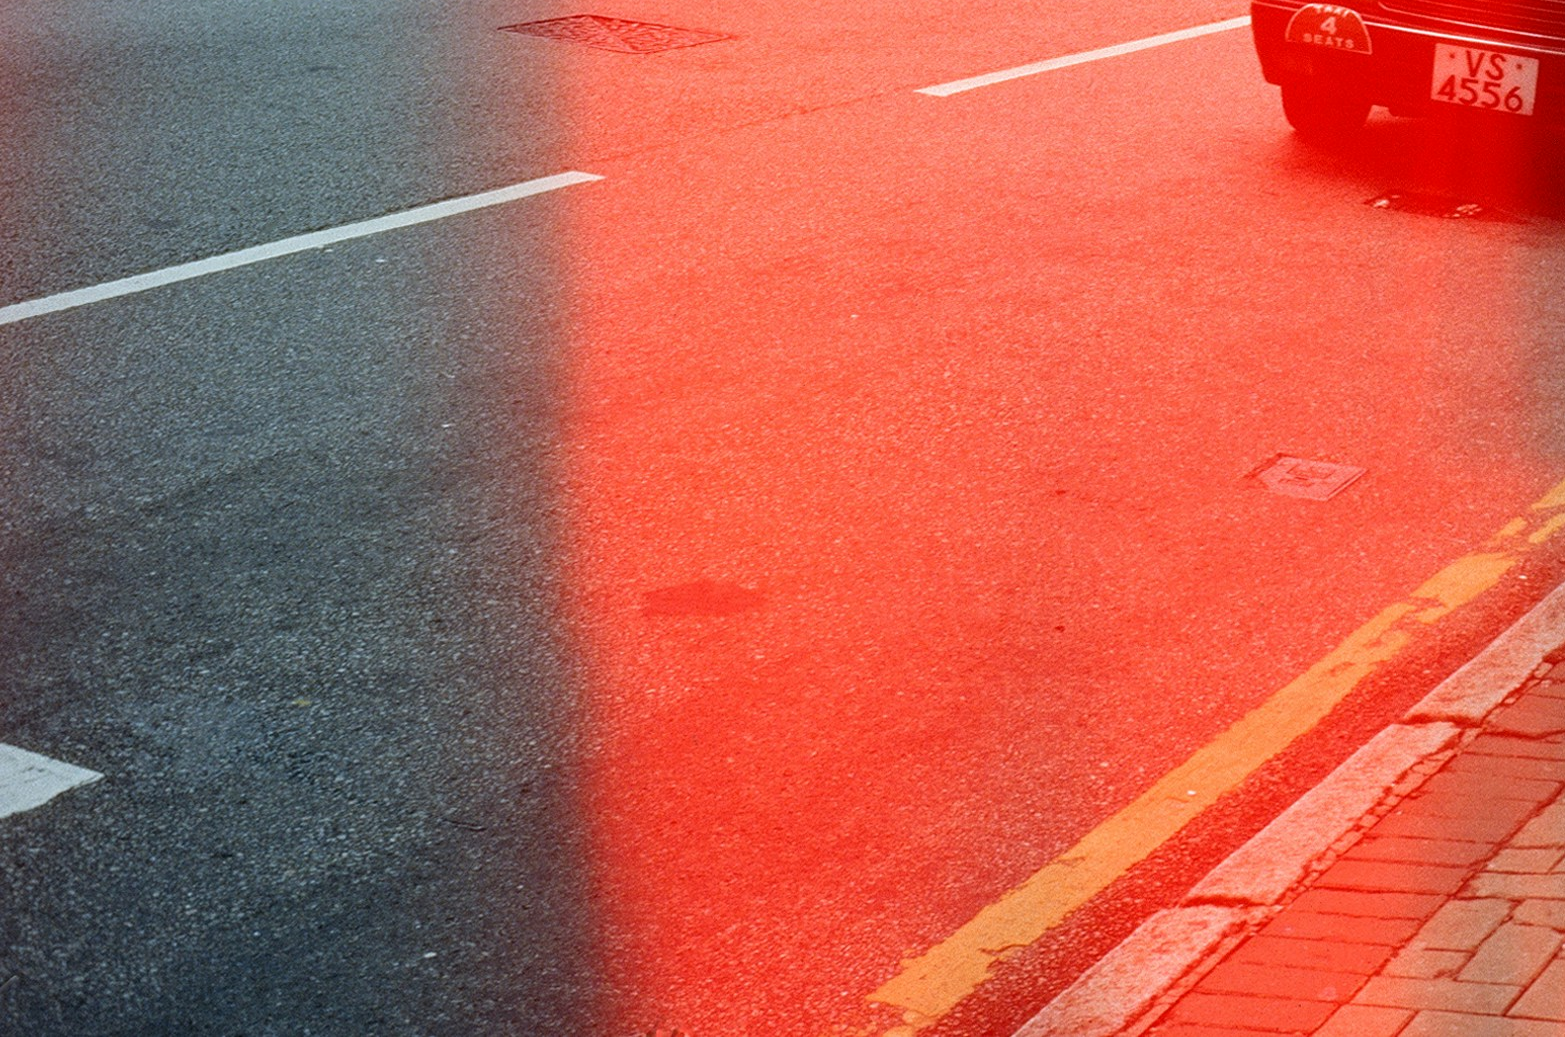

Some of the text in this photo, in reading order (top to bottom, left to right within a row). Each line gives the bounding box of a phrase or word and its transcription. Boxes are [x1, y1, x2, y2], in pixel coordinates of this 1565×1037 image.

[1320, 16, 1338, 35] 4
[1302, 32, 1355, 50] SEATS
[1465, 49, 1507, 81] VS
[1436, 74, 1524, 113] 4556
